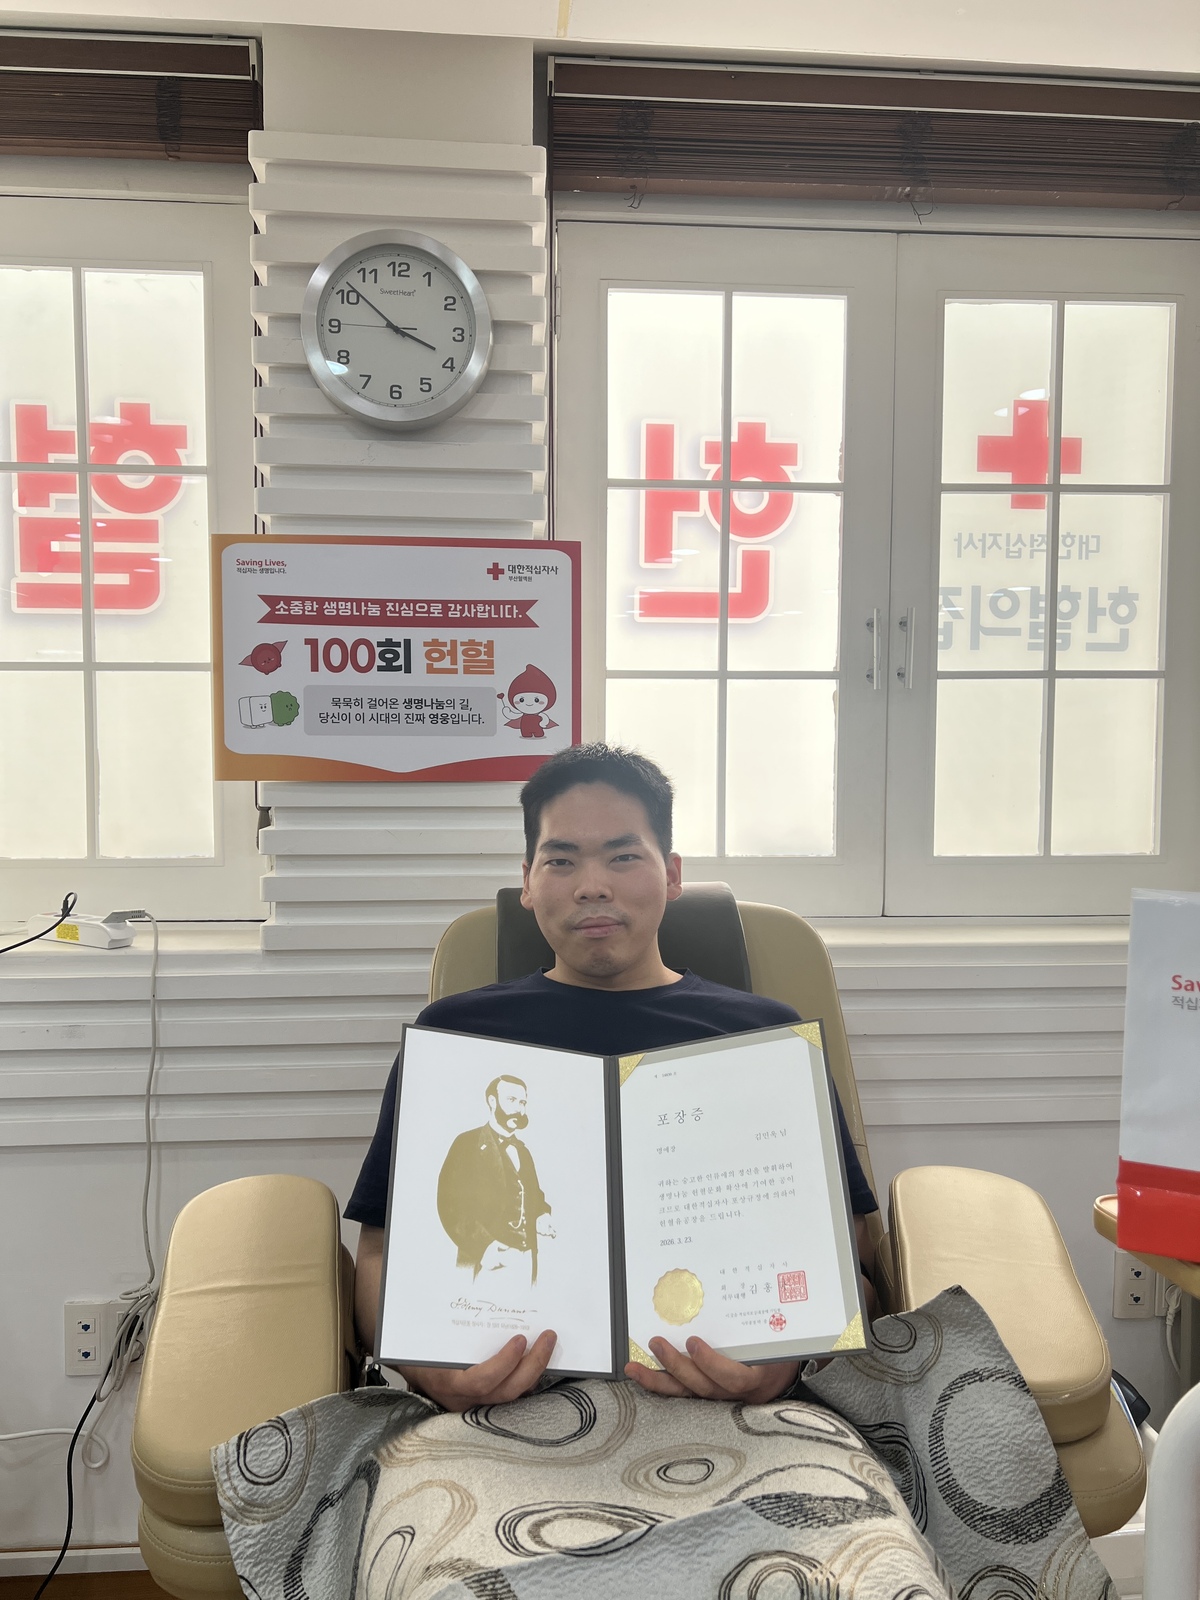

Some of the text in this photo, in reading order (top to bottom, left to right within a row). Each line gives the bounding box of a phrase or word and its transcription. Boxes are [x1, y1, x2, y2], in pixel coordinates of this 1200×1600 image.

[357, 267, 378, 284] 11
[387, 261, 411, 277] 12
[422, 272, 432, 287] 1
[336, 289, 360, 305] 10
[379, 288, 416, 297] SweetHeart
[443, 296, 457, 311] 2
[328, 318, 341, 334] 9
[452, 327, 465, 342] 3
[337, 349, 350, 365] 8
[441, 357, 456, 372] 4
[359, 374, 372, 389] 7
[419, 377, 432, 392] 5
[389, 385, 402, 400] 6
[236, 559, 287, 568] Saving Lives,
[507, 564, 559, 575] 대한적십자사
[275, 600, 522, 618] 소중한 생명나눔 진심으로 감사합니다.
[304, 637, 495, 675] 100회 헌혈
[330, 697, 473, 712] 묵묵히 걸어온 생명나눔의 길,
[318, 712, 485, 725] 당신이 이 시대의 진짜 영웅입니다.
[1171, 995, 1200, 1011] 적십
[683, 1197, 728, 1211] 대한적십자사
